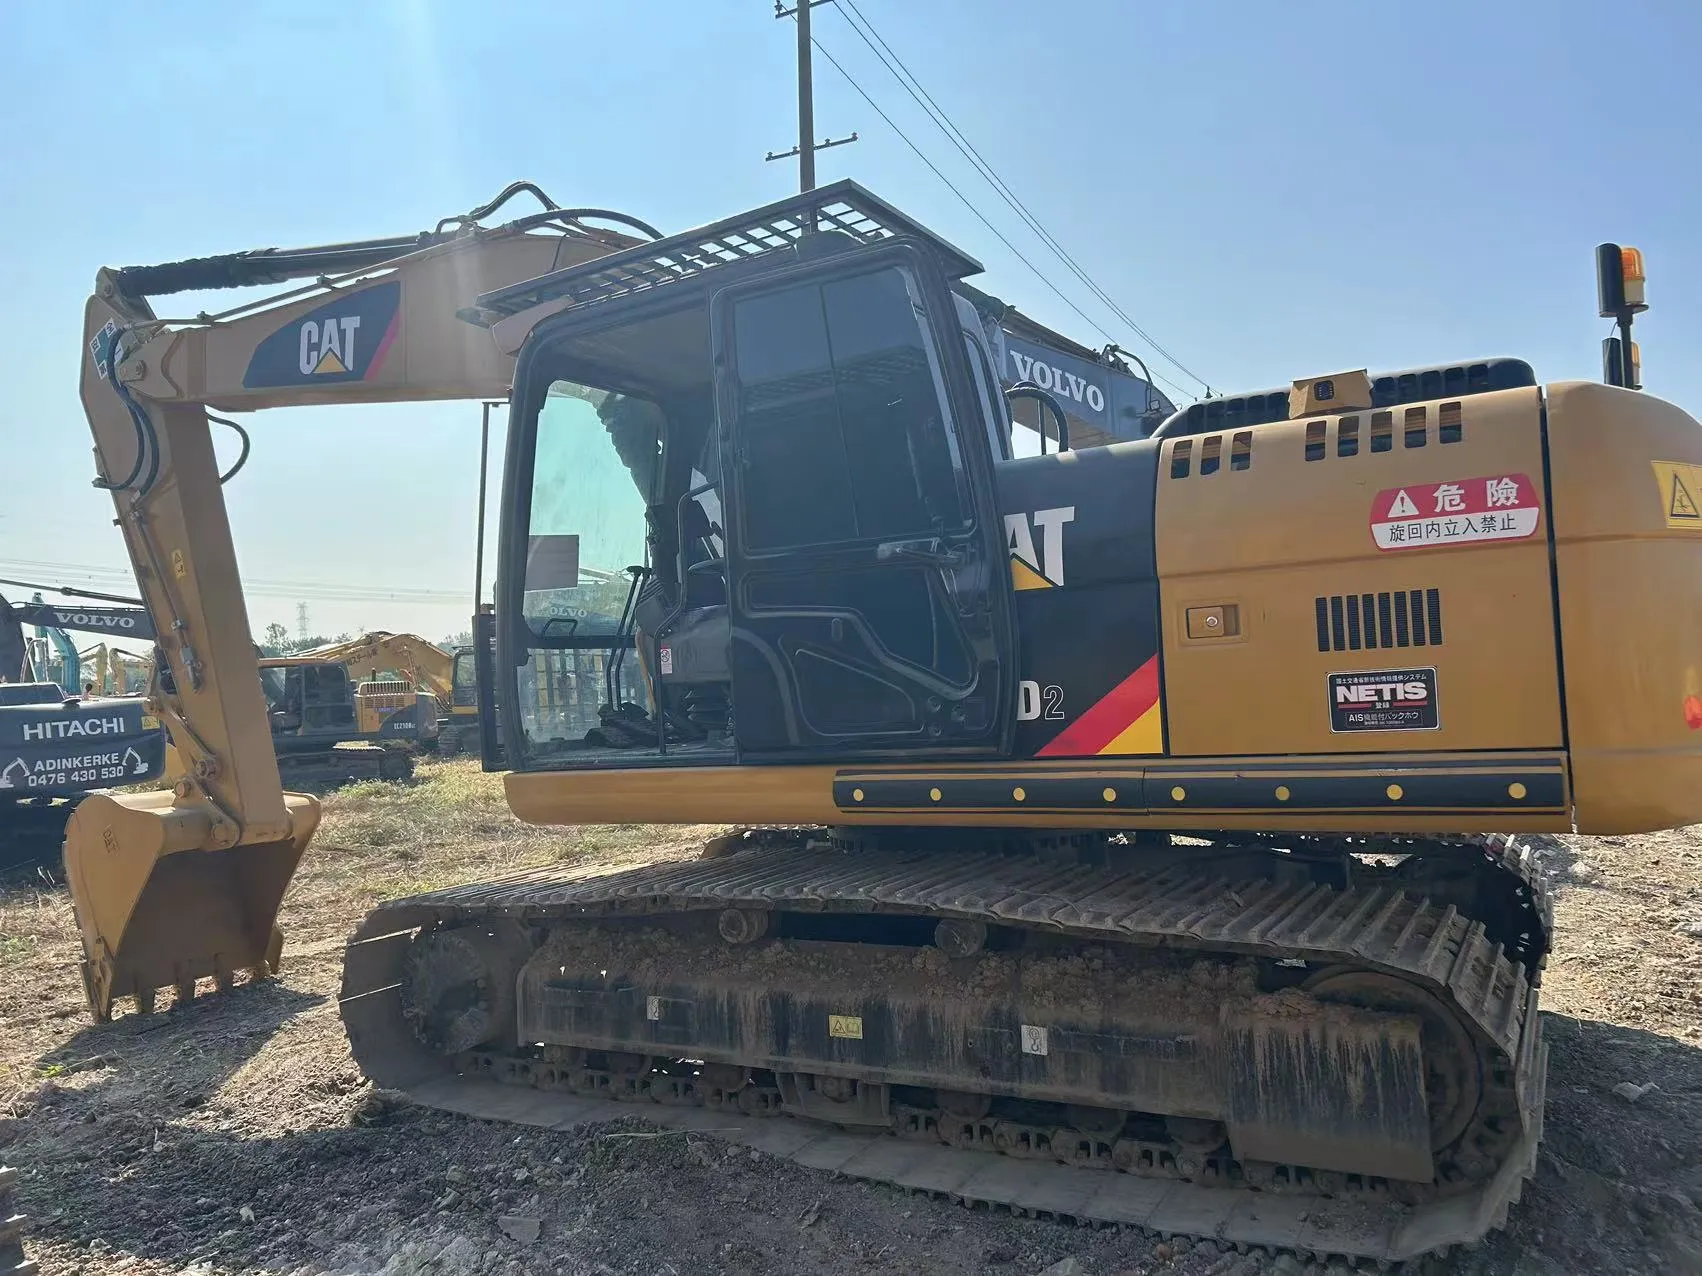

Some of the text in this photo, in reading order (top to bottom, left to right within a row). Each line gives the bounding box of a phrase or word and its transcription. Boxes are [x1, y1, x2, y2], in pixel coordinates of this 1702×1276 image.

[300, 316, 361, 375] CAT
[1010, 350, 1104, 412] VOLVO
[1389, 513, 1517, 543] 旋回内立入禁止
[1004, 506, 1075, 587] AT
[53, 612, 135, 628] VOLVO
[550, 606, 588, 618] OLVO
[1336, 681, 1428, 703] NETIS
[23, 717, 125, 741] HITACHI
[34, 752, 120, 772] ADINKERKE
[28, 766, 124, 787] 0476 430 530
